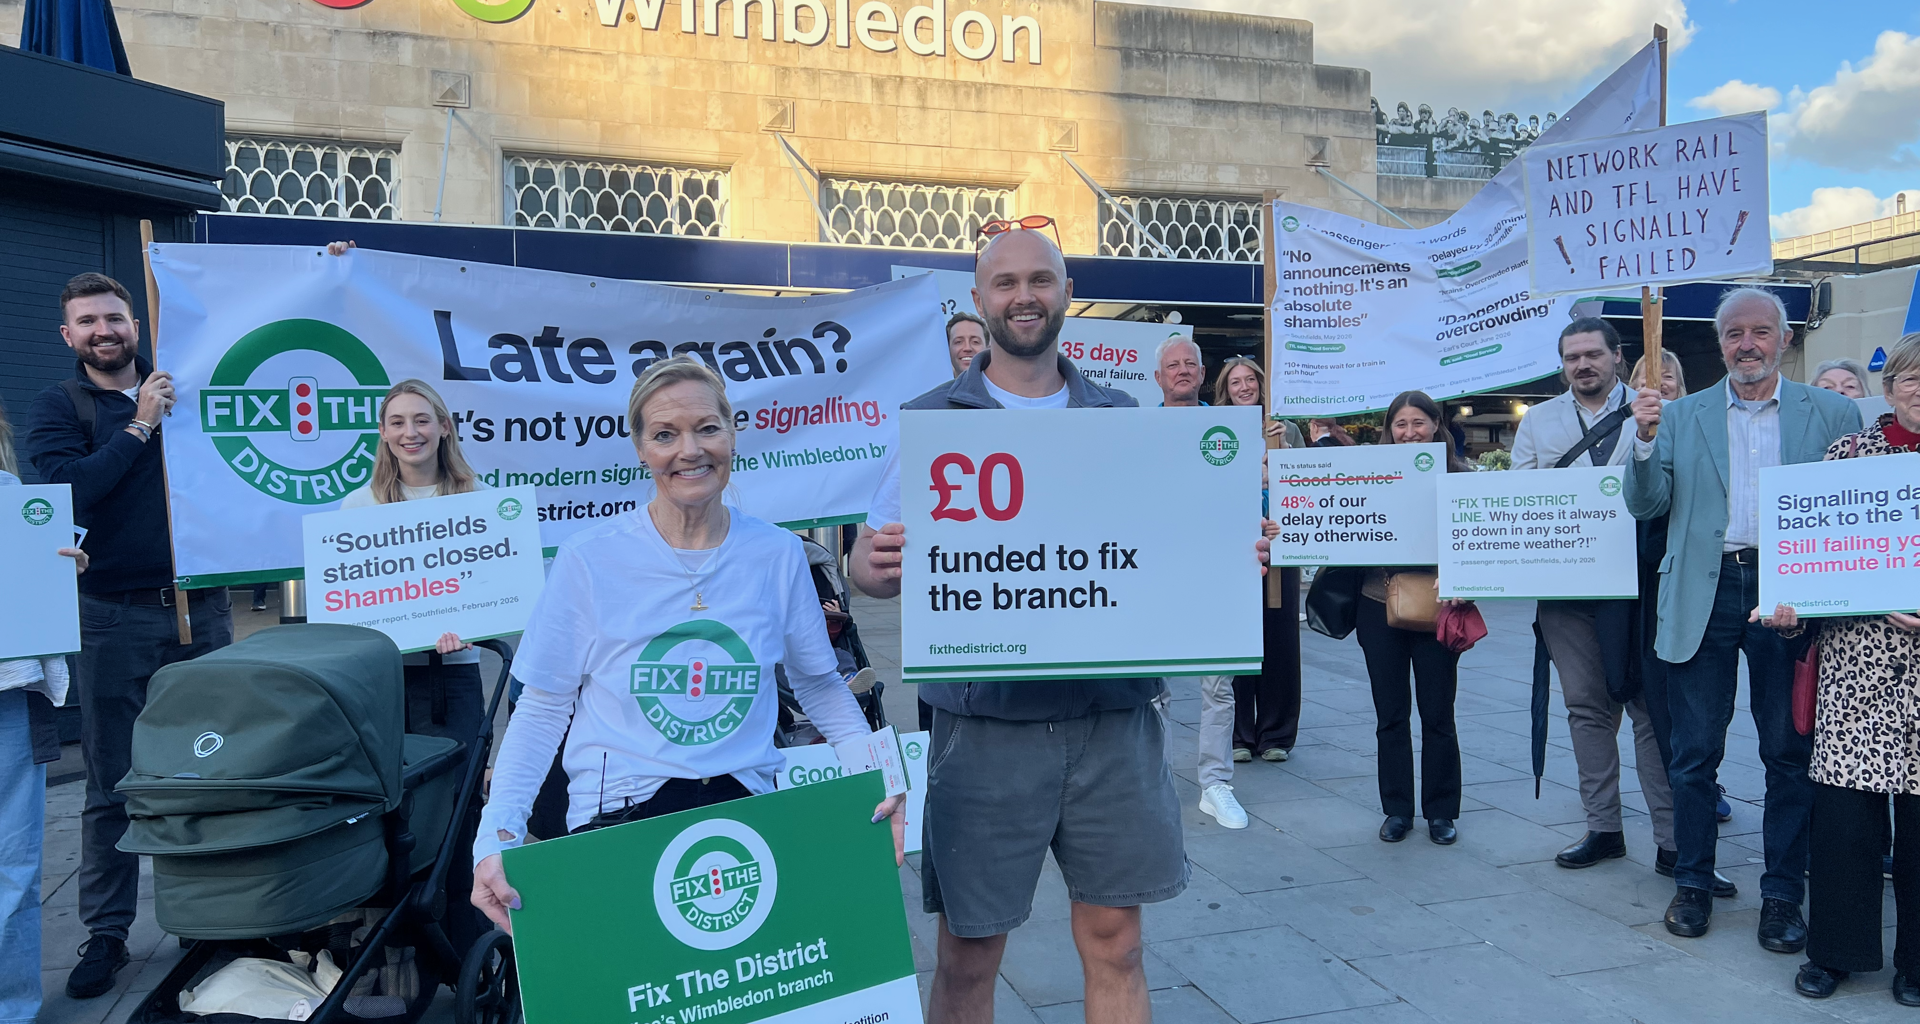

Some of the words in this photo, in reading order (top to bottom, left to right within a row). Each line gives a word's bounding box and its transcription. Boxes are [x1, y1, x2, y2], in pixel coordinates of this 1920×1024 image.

[1546, 143, 1659, 182] NETWORK
[1676, 132, 1738, 162] RAIL
[1549, 190, 1594, 218] AND
[1612, 181, 1657, 208] TFL
[1678, 168, 1742, 200] HAVE
[1586, 208, 1709, 247] SIGNALLY
[1283, 262, 1411, 280] announcements
[1599, 248, 1696, 280] FAILED
[1293, 281, 1358, 296] nothing.
[1360, 278, 1384, 292] It's
[1388, 278, 1408, 289] an
[1465, 268, 1510, 290] Overcrowded
[1284, 300, 1352, 312] absolute
[1495, 330, 1512, 340] 2026
[434, 310, 616, 384] Late
[1090, 344, 1138, 366] days
[1080, 367, 1106, 378] ignal
[1110, 368, 1148, 380] failure.
[1424, 383, 1446, 392] reports
[1484, 368, 1516, 378] Wimbledon
[1518, 360, 1538, 370] branch
[1284, 394, 1365, 404] fixthedistrict.org
[206, 395, 282, 426] FIX
[452, 410, 495, 442] t's
[504, 412, 566, 442] not
[755, 396, 888, 434] signalling.
[506, 467, 596, 488] modern
[762, 446, 868, 468] Wimbledon
[1204, 452, 1234, 465] DISTRICT
[231, 442, 375, 500] DISTRICT
[930, 452, 1024, 522] £0
[1281, 496, 1315, 509] 48%
[1319, 495, 1335, 508] of
[1339, 496, 1367, 508] our
[1482, 497, 1510, 508] THE
[1514, 494, 1578, 507] DISTRICT
[1778, 488, 1889, 513] Signalling
[1896, 484, 1920, 501] da
[26, 516, 51, 525] DISTRICT
[537, 500, 636, 522] strict.org
[1282, 513, 1324, 528] delay
[1328, 512, 1387, 527] reports
[1452, 512, 1485, 523] LINE.
[1489, 510, 1518, 523] Why
[1522, 510, 1554, 521] does
[1558, 509, 1566, 520] it
[1570, 508, 1617, 520] always
[1778, 511, 1831, 530] back
[1837, 511, 1859, 526] to
[1866, 507, 1903, 523] the
[1282, 532, 1309, 546] say
[1314, 529, 1398, 542] otherwise.
[1452, 528, 1468, 540] go
[1472, 526, 1507, 537] down
[1511, 525, 1523, 535] in
[1526, 526, 1550, 538] any
[1554, 523, 1581, 534] sort
[1452, 540, 1465, 551] of
[1468, 540, 1520, 550] extreme
[1778, 538, 1816, 555] Still
[1823, 535, 1890, 553] failing
[1897, 534, 1920, 551] yo
[323, 555, 415, 584] station
[423, 538, 518, 569] closed.
[928, 544, 1046, 574] funded
[1056, 544, 1088, 571] to
[1098, 542, 1138, 570] fix
[1778, 556, 1879, 575] commute
[1886, 553, 1906, 569] in
[928, 584, 982, 612] the
[993, 580, 1118, 610] branch.
[382, 614, 409, 624] report,
[411, 604, 460, 620] Southfields,
[462, 600, 498, 612] February
[500, 596, 519, 605] 2026
[929, 642, 1027, 655] fixthedistrict.org
[634, 668, 682, 690] FIX
[710, 670, 757, 690] THE
[646, 703, 743, 742] DISTRICT
[672, 878, 707, 900] FIX
[724, 866, 760, 886] THE
[685, 892, 754, 930] DISTRICT
[628, 982, 672, 1012] Fix
[676, 968, 729, 998] The
[735, 937, 829, 982] District
[678, 987, 774, 1024] Wimbledon
[778, 968, 834, 998] branch
